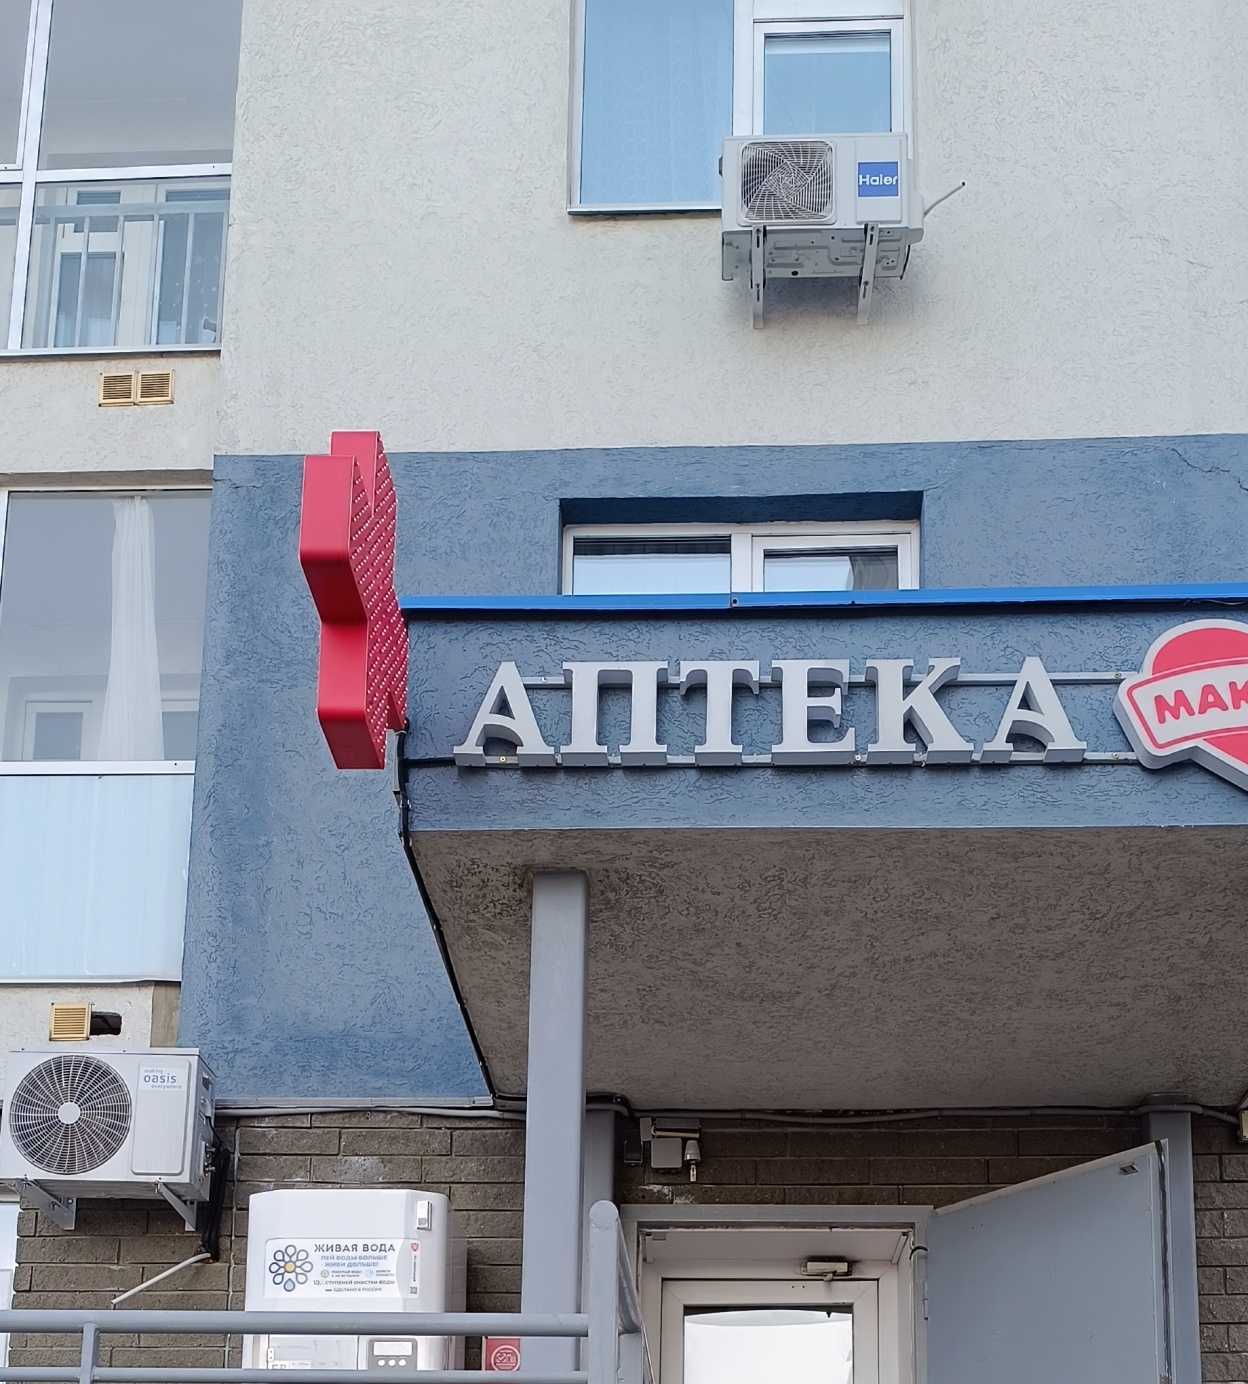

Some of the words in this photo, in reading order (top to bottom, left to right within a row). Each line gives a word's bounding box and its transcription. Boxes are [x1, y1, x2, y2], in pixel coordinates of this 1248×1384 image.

[858, 174, 898, 185] Haier
[453, 657, 1087, 766] АПТЕКА
[144, 1073, 176, 1083] oasis
[314, 1244, 358, 1253] ЖИВАЯ
[362, 1244, 395, 1253] ВОДА
